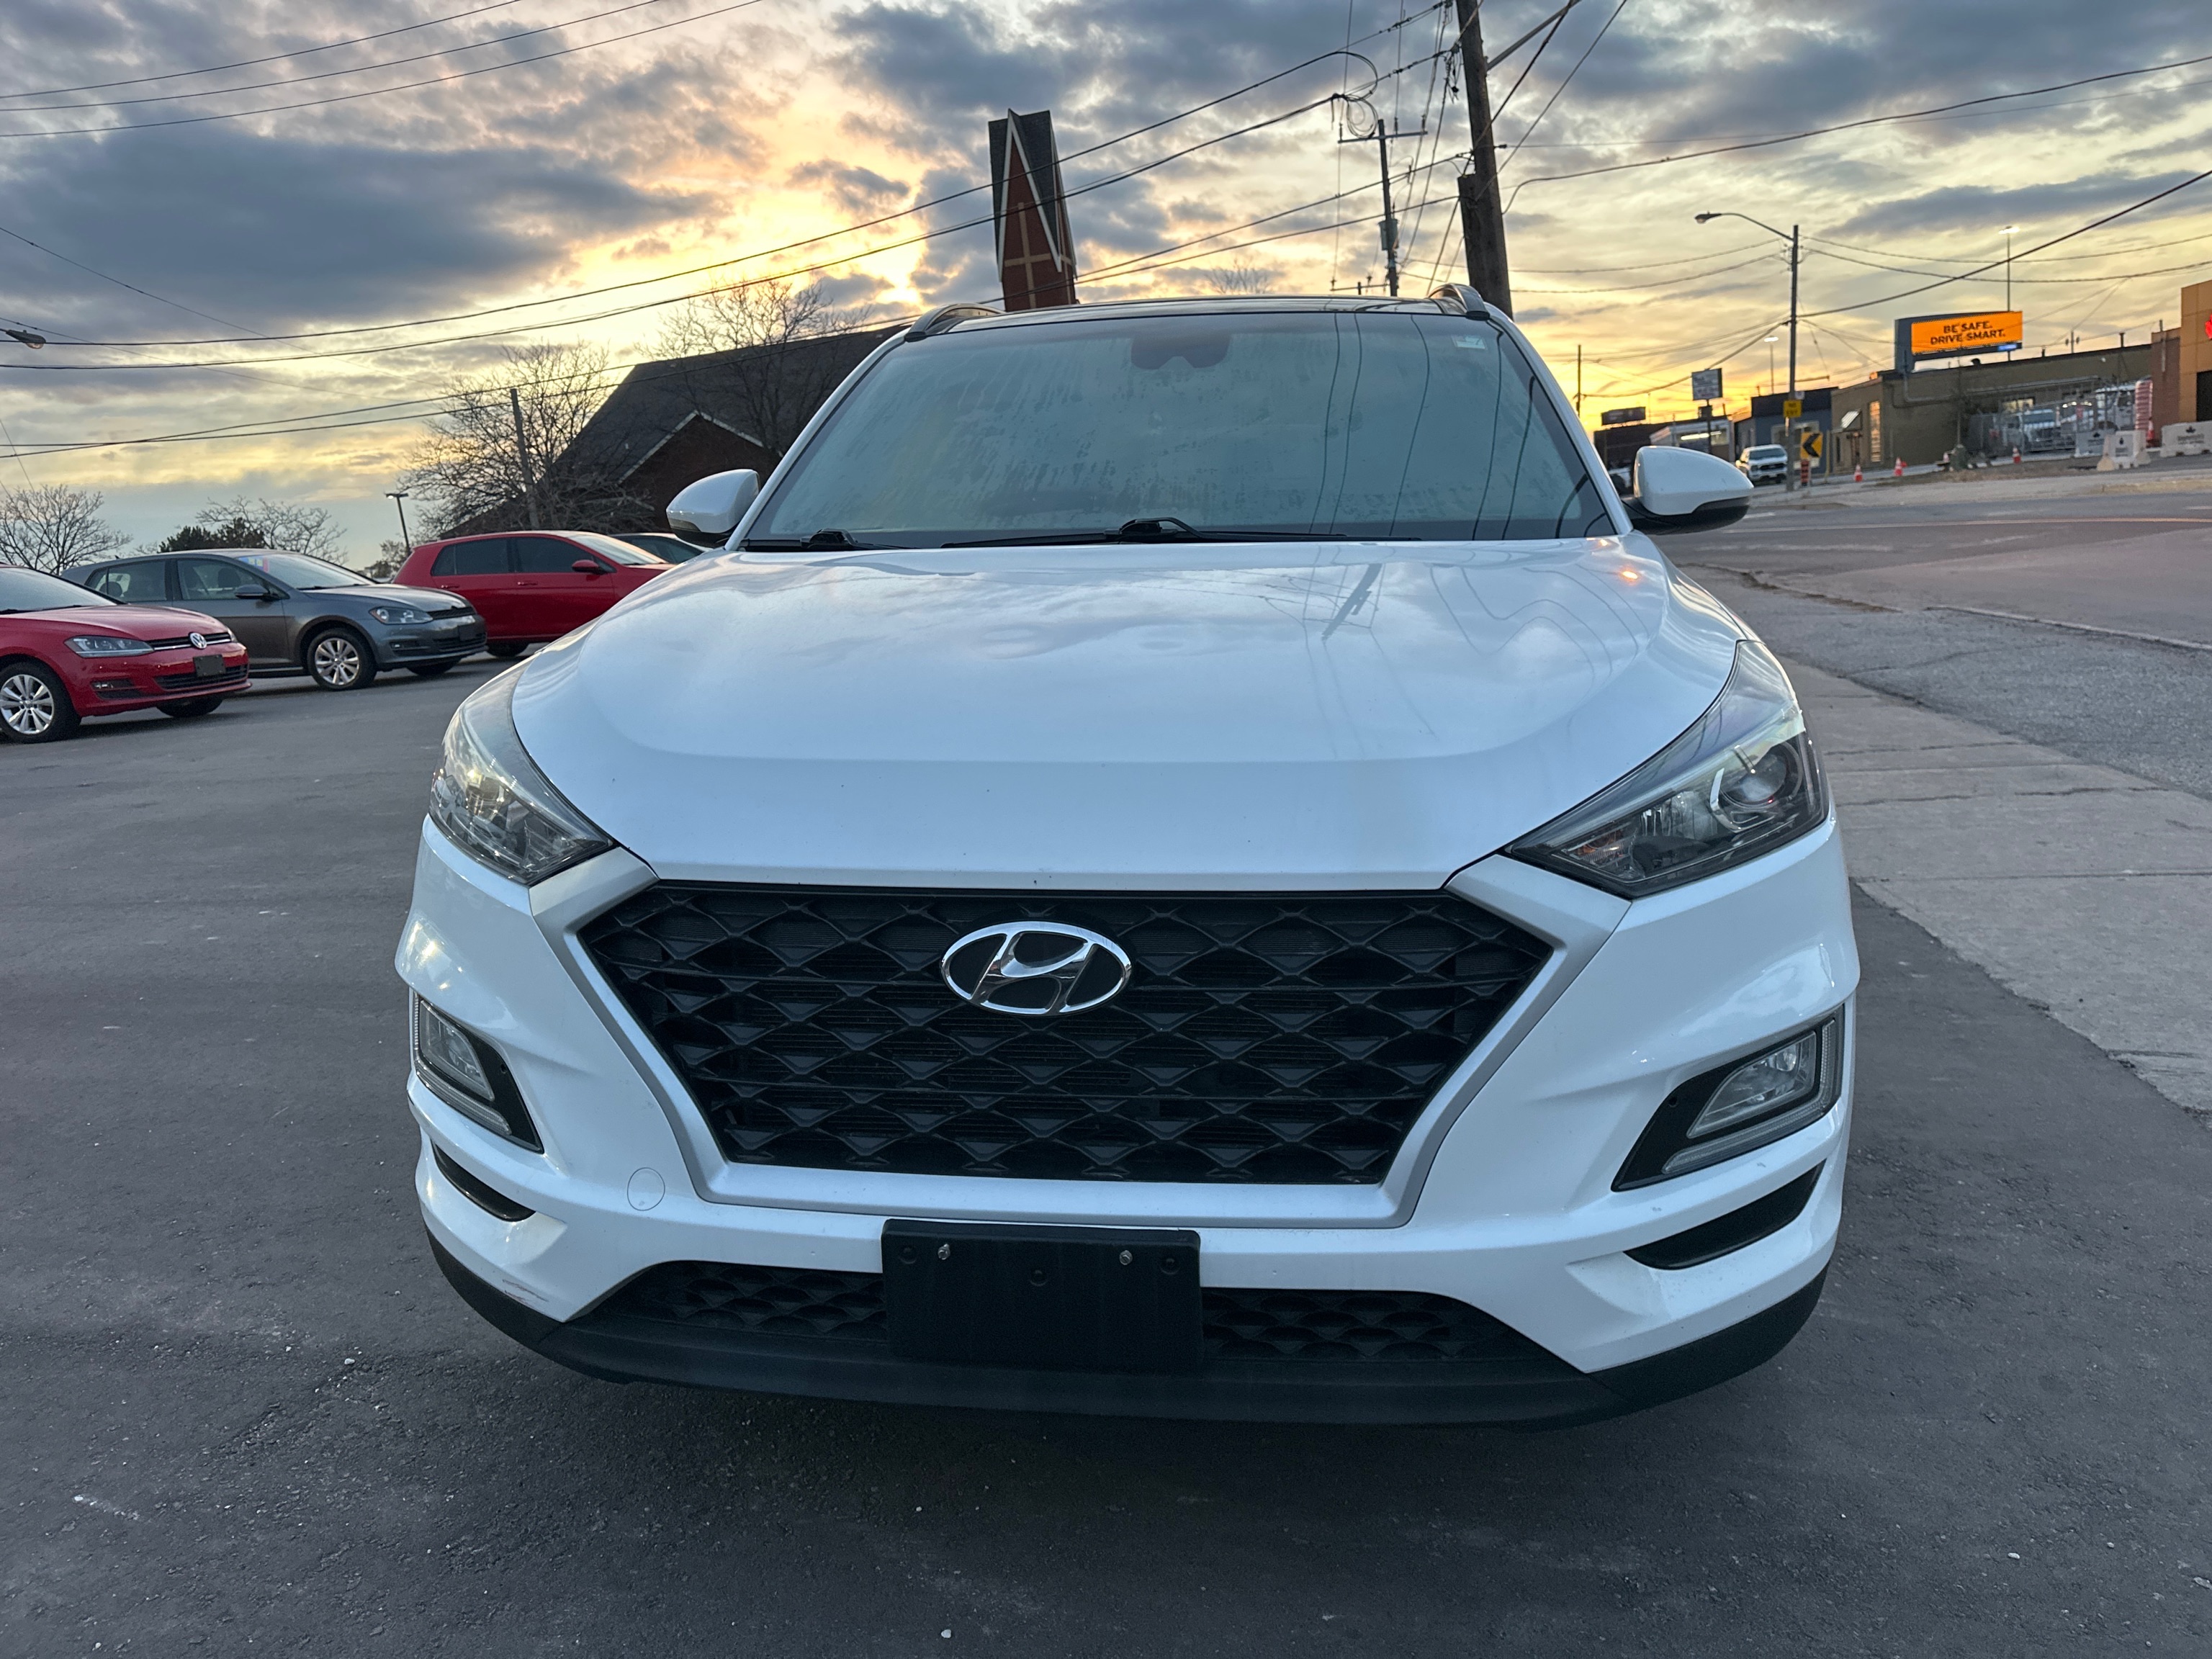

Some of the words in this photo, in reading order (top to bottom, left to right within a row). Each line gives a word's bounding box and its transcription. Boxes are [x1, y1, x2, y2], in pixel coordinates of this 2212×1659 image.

[1943, 324, 1959, 333] BE
[1961, 321, 1992, 331] SAFE.
[1930, 333, 1963, 345] DRIVE
[1966, 329, 2005, 341] SMART.
